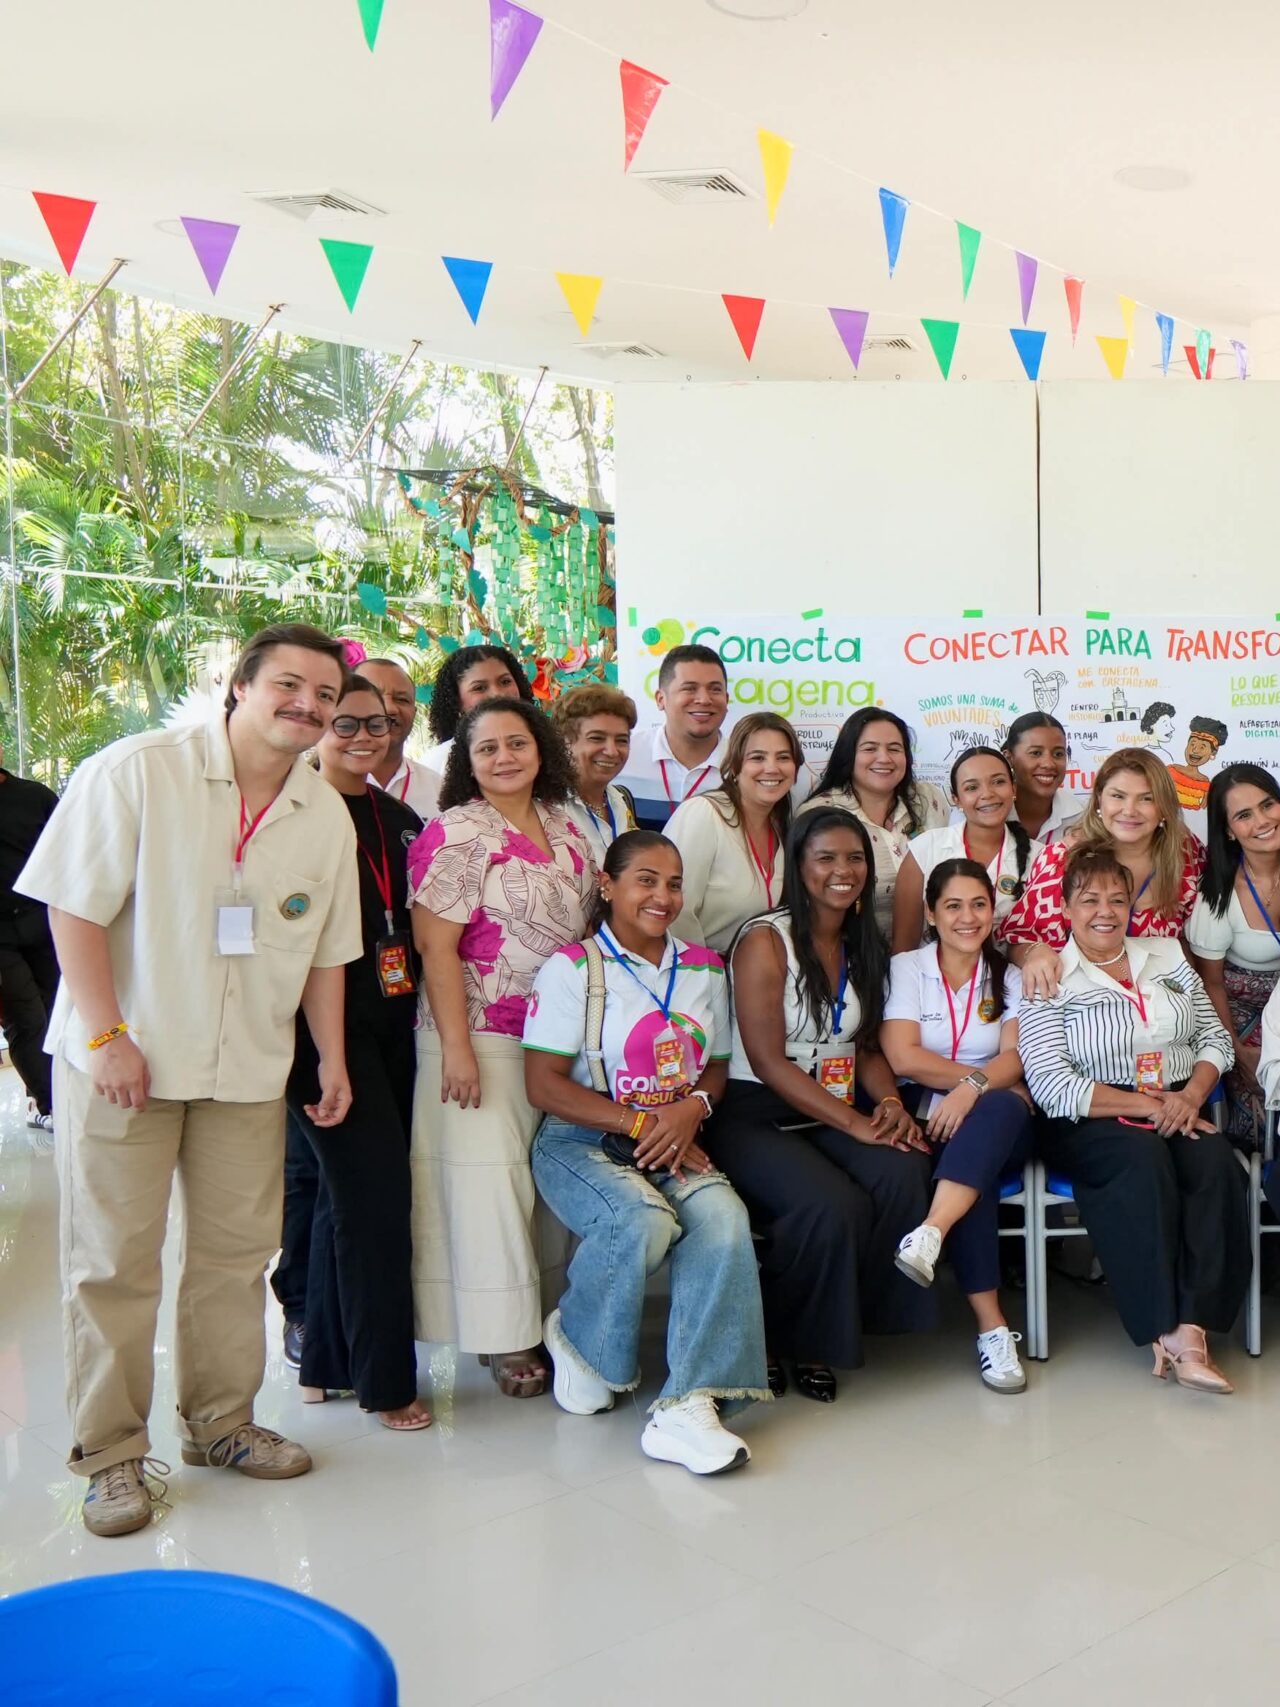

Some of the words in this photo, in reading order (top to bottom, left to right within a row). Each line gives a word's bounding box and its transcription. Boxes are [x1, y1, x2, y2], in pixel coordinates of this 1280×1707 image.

[691, 627, 861, 664] Conecta
[904, 627, 1069, 665] CONECTAR
[1086, 627, 1152, 660] PARA
[1098, 667, 1140, 677] CONECTA
[1231, 676, 1247, 691] LO
[1252, 674, 1278, 689] QUE
[918, 694, 953, 712] SOMOS
[957, 694, 976, 705] UNA
[980, 695, 1005, 709] SUMA
[1071, 703, 1099, 712] CENTRO
[800, 709, 844, 719] Productiva
[923, 707, 1001, 728] VOLUNTADES
[1074, 732, 1098, 742] PLAYA
[1245, 730, 1280, 738] DIGITAL
[800, 740, 834, 752] STRUYE
